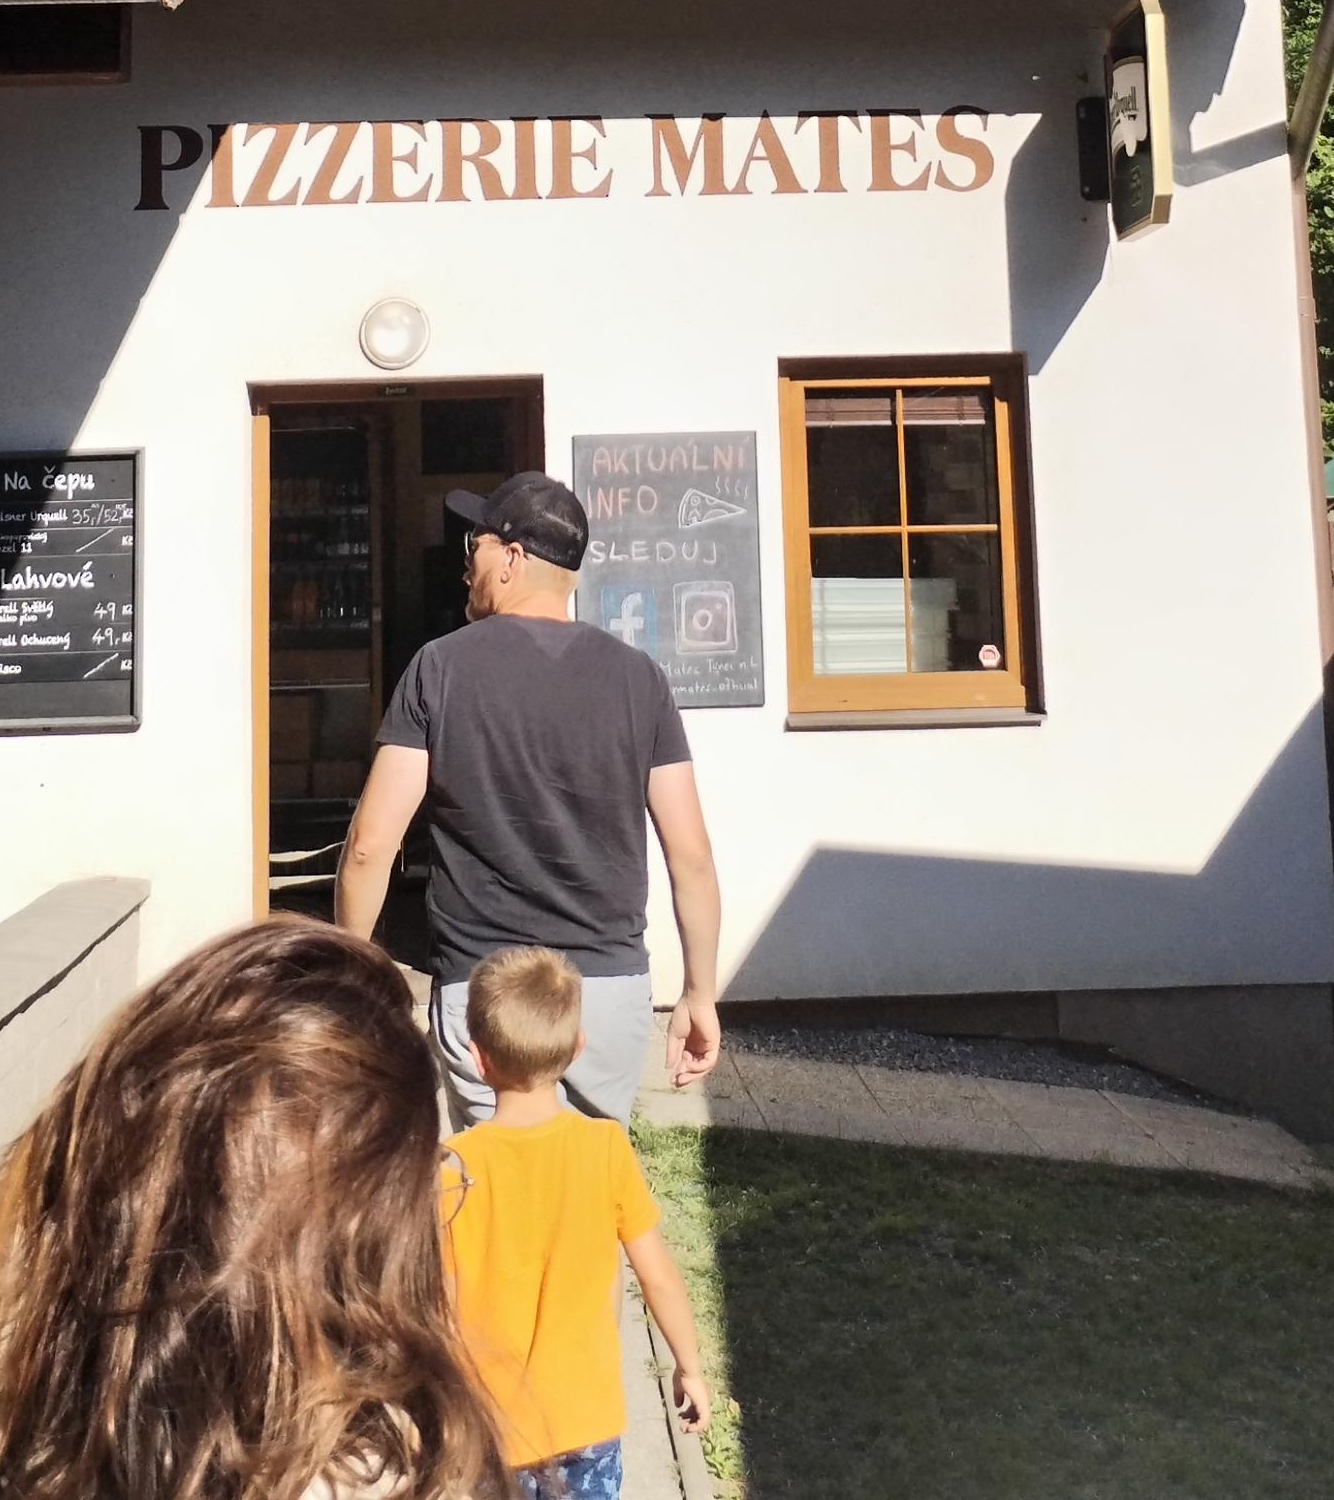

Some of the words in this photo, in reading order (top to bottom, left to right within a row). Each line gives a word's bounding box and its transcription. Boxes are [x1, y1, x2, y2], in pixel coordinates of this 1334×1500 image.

[134, 113, 614, 211] PIZZERIE
[644, 105, 996, 198] MATES
[4, 472, 30, 491] Na
[42, 466, 96, 499] čepu
[586, 484, 659, 520] INFO
[589, 540, 717, 565] SLEDUJ
[0, 561, 95, 590] Lahvové
